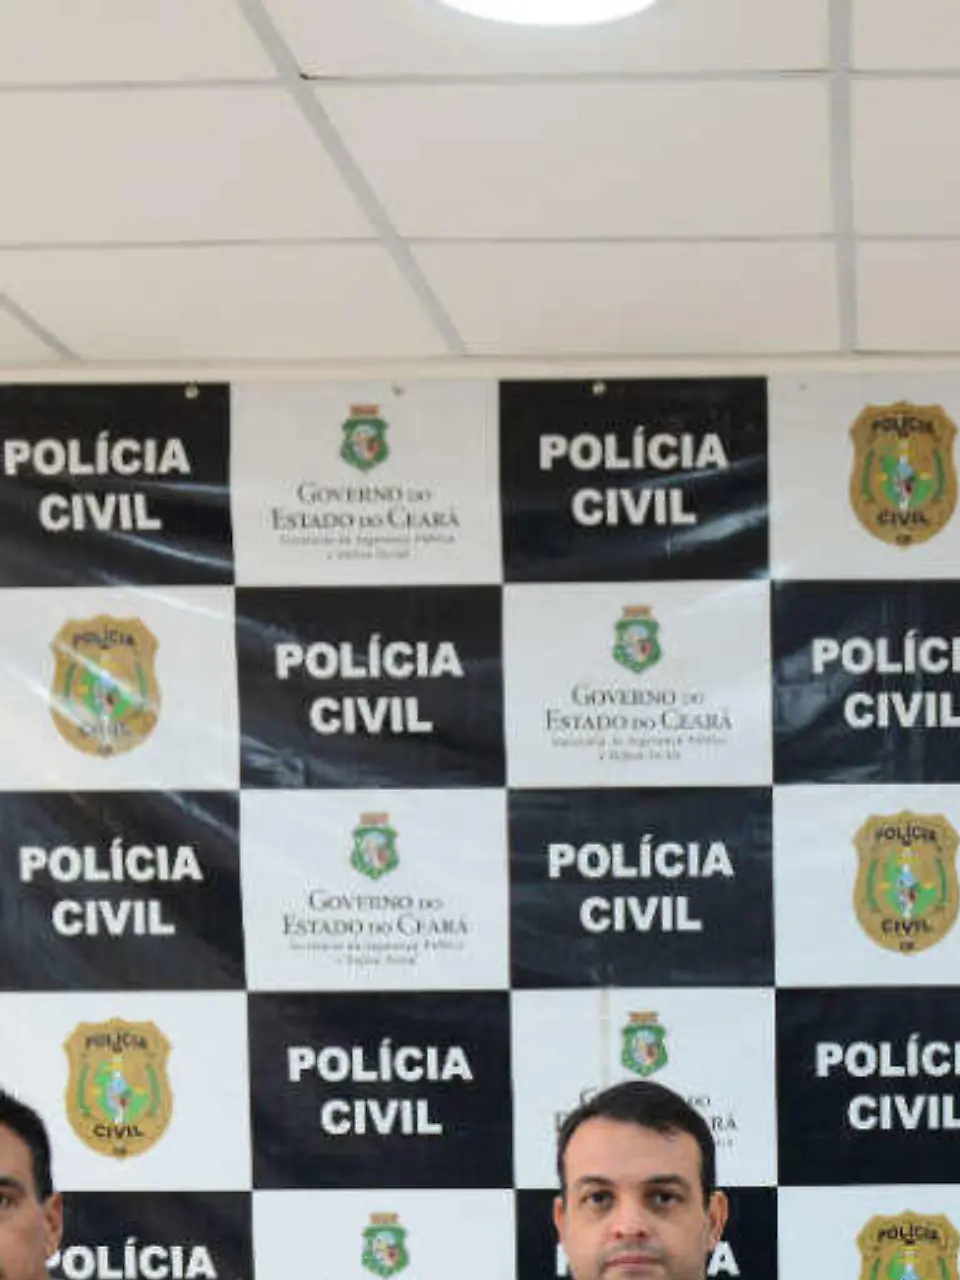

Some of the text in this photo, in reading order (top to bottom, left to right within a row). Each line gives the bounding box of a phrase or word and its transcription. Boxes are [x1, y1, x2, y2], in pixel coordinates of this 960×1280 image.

[5, 432, 190, 475] POLÍCIA
[540, 426, 728, 470] POLÍCIA
[40, 494, 161, 530] CIVIL
[573, 488, 696, 525] CIVIL
[276, 635, 463, 679] POLÍCIA
[310, 697, 432, 733] CIVIL
[20, 838, 202, 882] POLÍCIA
[549, 834, 733, 877] POLÍCIA
[53, 900, 175, 935] CIVIL
[580, 896, 701, 932] CIVIL
[288, 1039, 472, 1081] POLÍCIA
[322, 1100, 442, 1134] CIVIL
